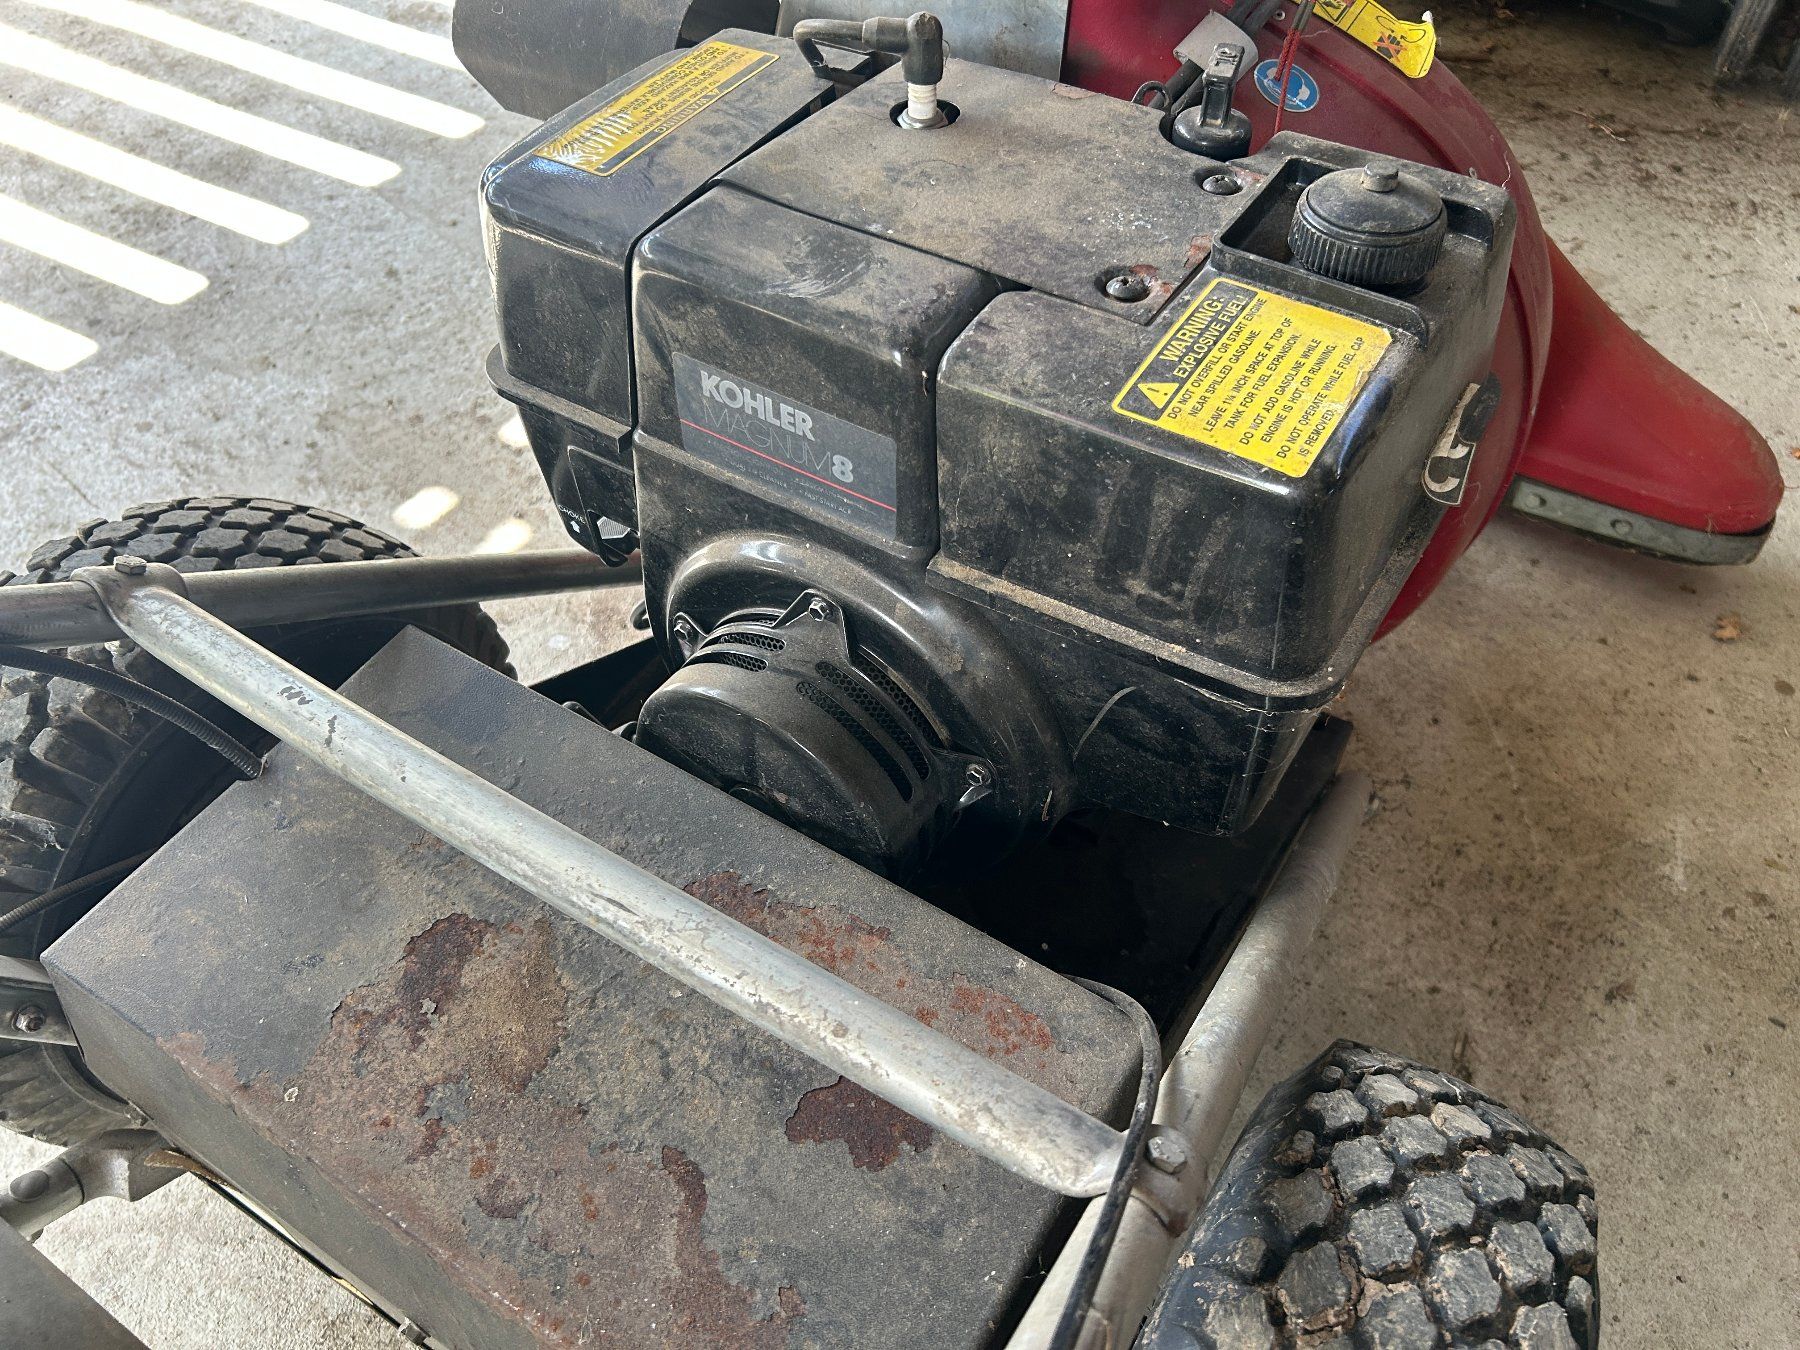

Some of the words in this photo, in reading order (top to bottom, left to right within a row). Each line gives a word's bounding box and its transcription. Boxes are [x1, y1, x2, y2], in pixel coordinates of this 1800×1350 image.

[652, 97, 709, 133] WARNING
[1158, 293, 1227, 364] WARNING:
[1166, 406, 1183, 419] DO
[1177, 389, 1196, 405] NOT
[1190, 354, 1223, 388] OVERFILL
[1217, 342, 1233, 354] OR
[1225, 321, 1248, 343] START
[1242, 297, 1267, 322] ENGINE
[1172, 321, 1227, 378] EXPLOSIVE
[1217, 294, 1248, 322] FUEL!
[1307, 342, 1337, 376] RUNNING.
[699, 369, 815, 442] KOHLER
[1187, 394, 1211, 417] NEAR
[1205, 364, 1233, 394] SPILLED
[1227, 328, 1261, 364] GASOLINE.
[1202, 406, 1228, 432] LEAVE
[1230, 374, 1252, 393] INCH
[1244, 351, 1269, 375] SPACE
[1262, 341, 1276, 351] AT
[1269, 327, 1286, 341] TOP
[1279, 316, 1294, 328] OF
[1224, 408, 1246, 430] TANK
[1239, 391, 1258, 408] FOR
[1251, 371, 1272, 391] FUEL
[1265, 331, 1301, 372] EXPANSION.
[1239, 431, 1256, 445] DO
[1249, 413, 1268, 431] NOT
[1261, 396, 1280, 413] ADD
[1273, 359, 1306, 396] GASOLINE
[1299, 338, 1321, 360] WHILE
[1276, 444, 1293, 459] DO
[1286, 426, 1305, 444] NOT
[1298, 392, 1328, 426] OPERATE
[1321, 369, 1344, 392] WHILE
[1336, 351, 1356, 369] FUEL
[1348, 336, 1366, 351] CAP
[1281, 404, 1295, 413] IS
[1287, 388, 1306, 404] HOT
[1299, 376, 1314, 388] OR
[1260, 413, 1289, 443] ENGINE
[1297, 447, 1311, 457] IS
